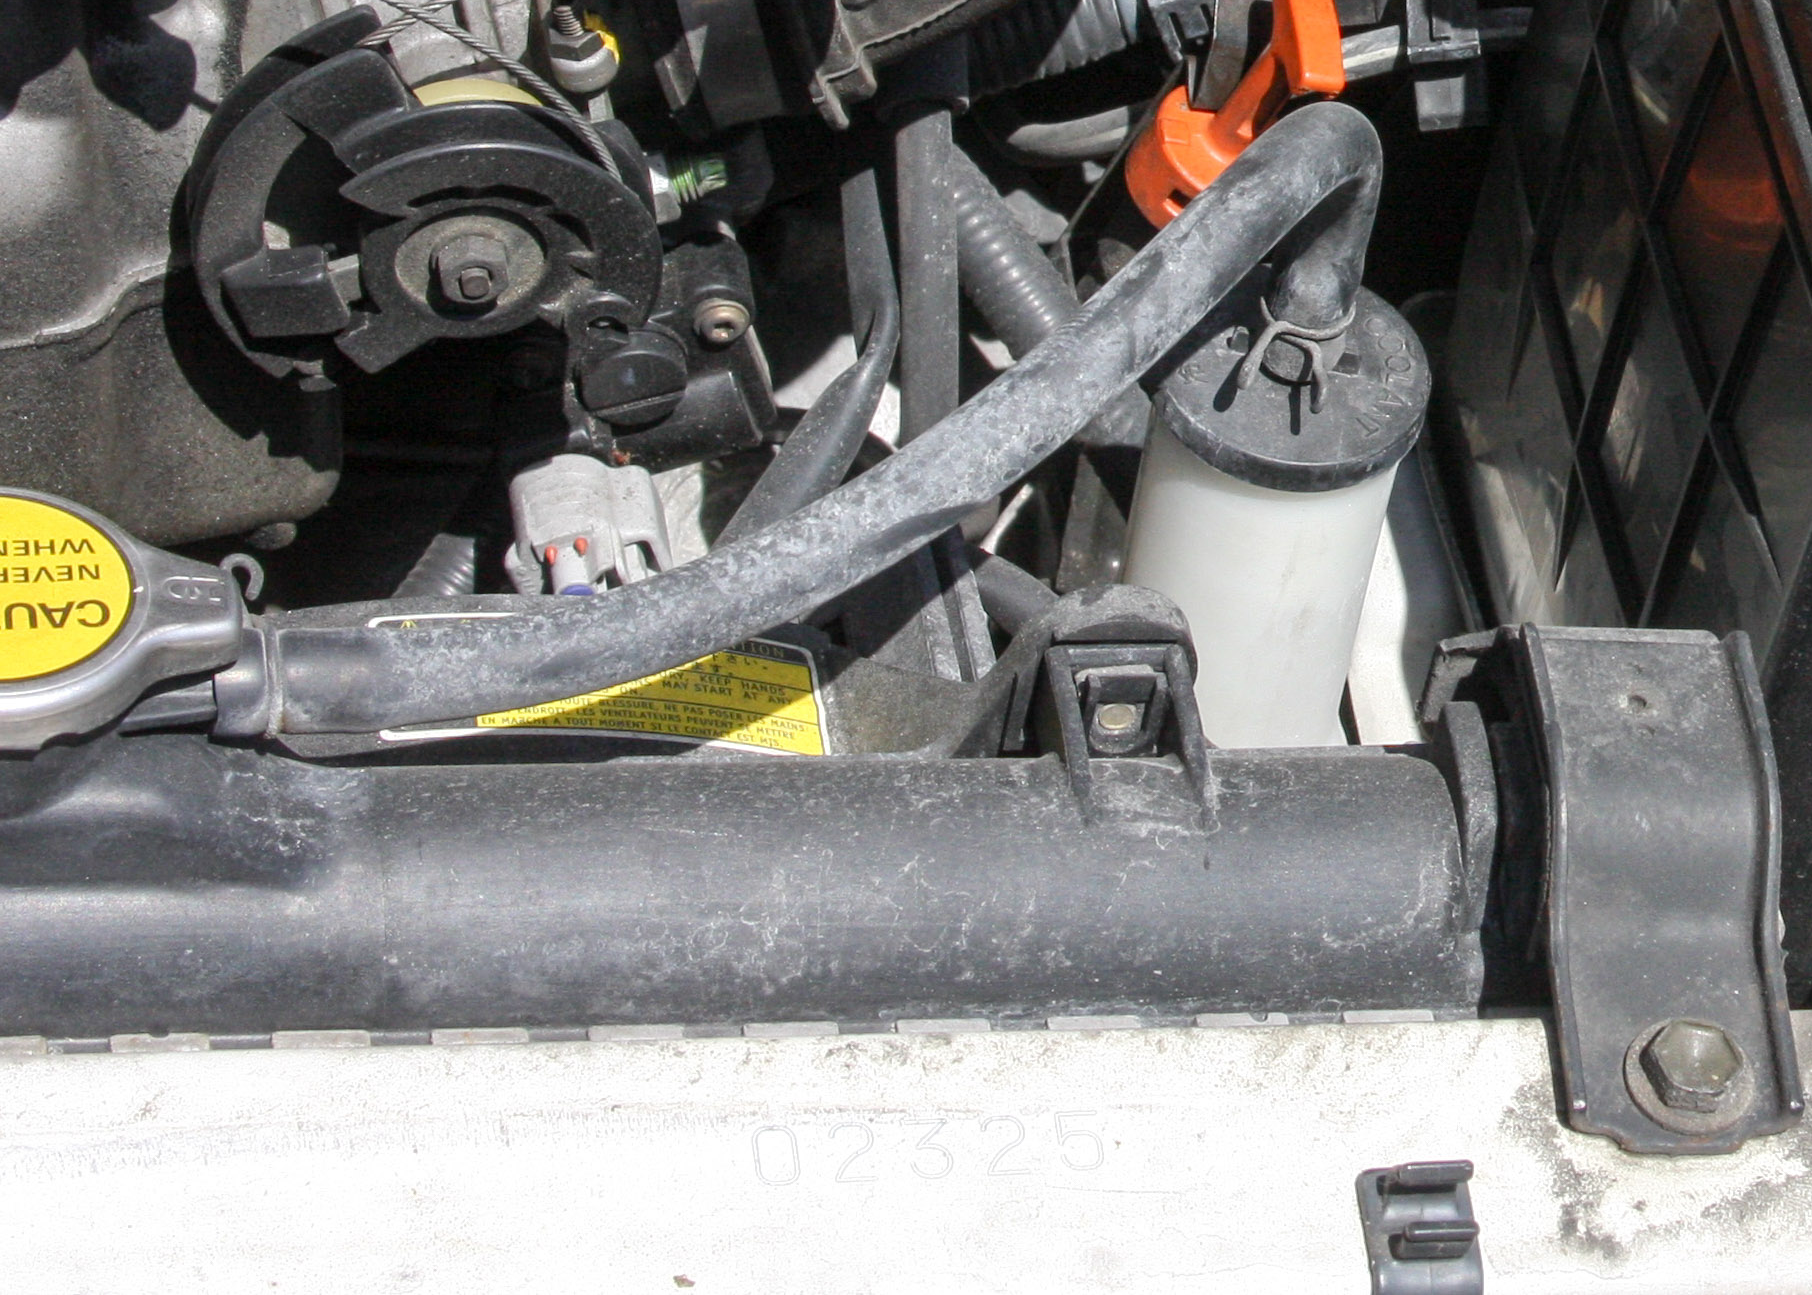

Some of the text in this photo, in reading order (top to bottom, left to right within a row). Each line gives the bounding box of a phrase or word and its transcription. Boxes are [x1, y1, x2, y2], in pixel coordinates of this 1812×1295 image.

[0, 599, 111, 631] CAU
[662, 680, 688, 692] MAY
[694, 685, 733, 697] START
[741, 681, 786, 697] HANDS
[683, 705, 704, 716] PAS
[708, 708, 743, 721] POSER
[566, 717, 594, 727] TOUT
[600, 718, 646, 731] MOMENT
[687, 716, 734, 729] PEUVENT
[752, 1110, 1105, 1187] 02325
